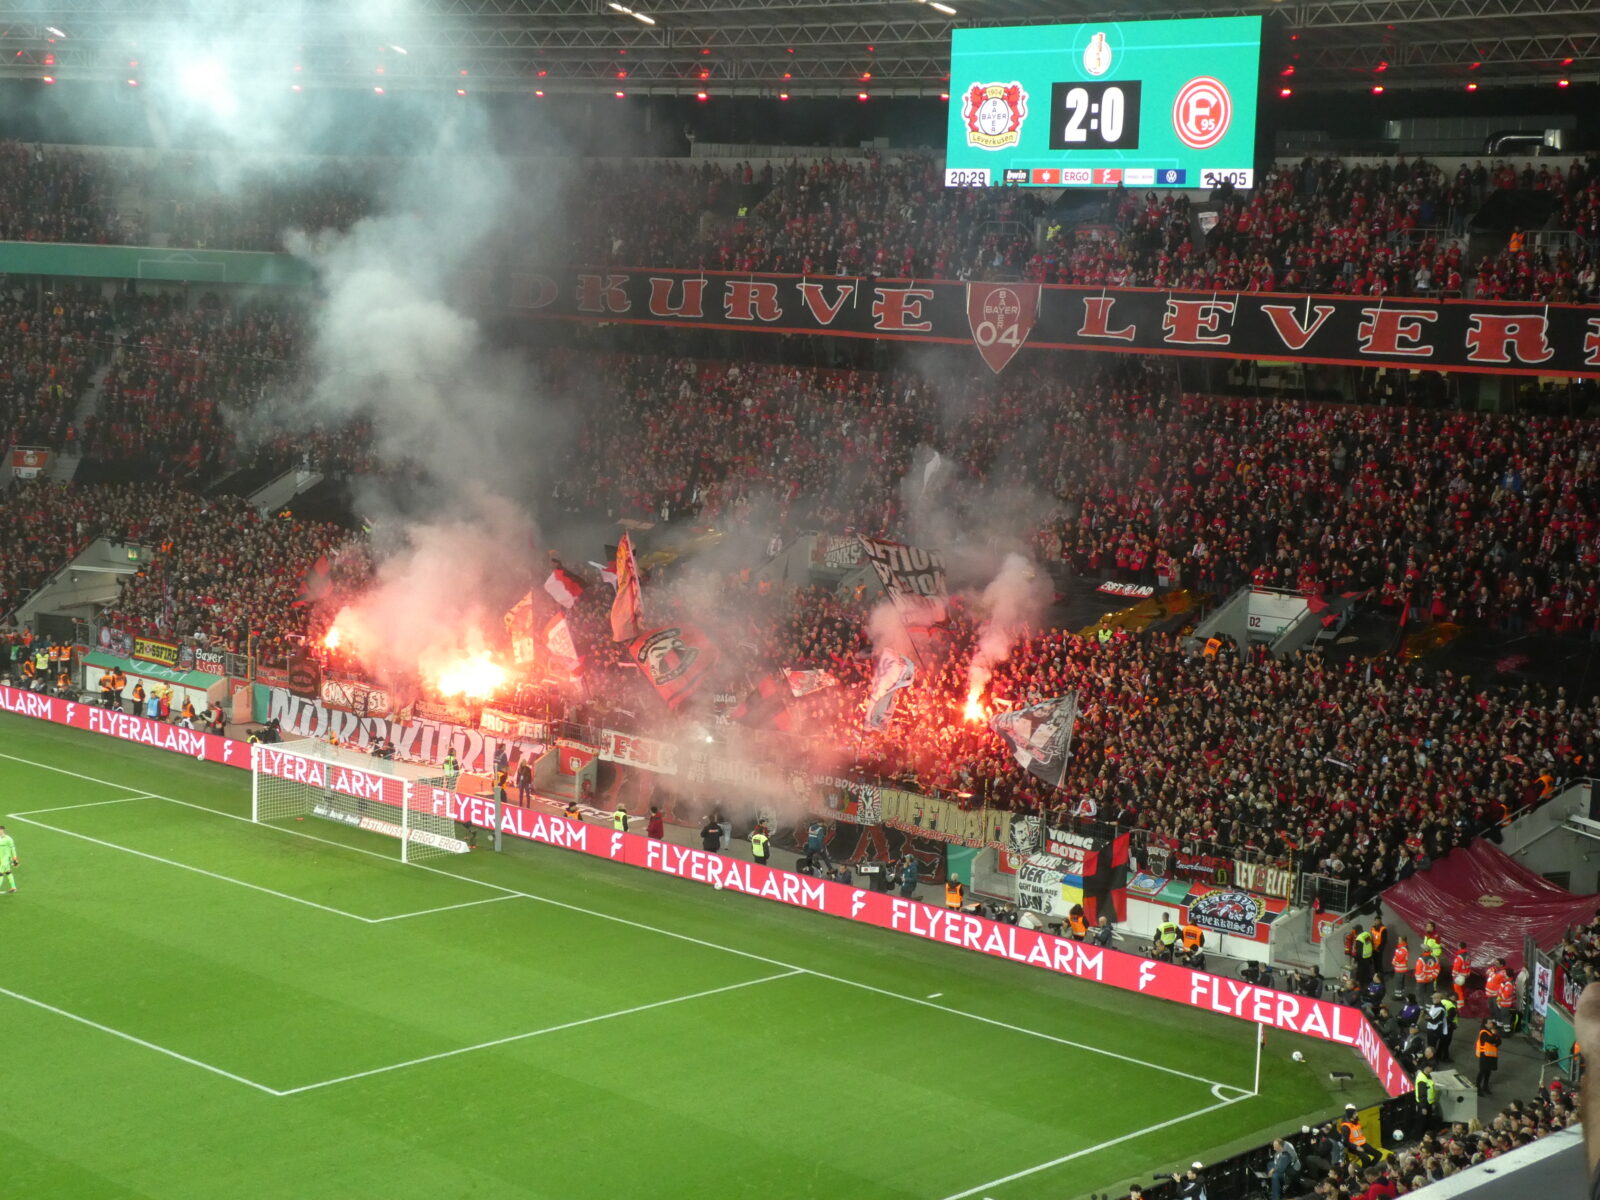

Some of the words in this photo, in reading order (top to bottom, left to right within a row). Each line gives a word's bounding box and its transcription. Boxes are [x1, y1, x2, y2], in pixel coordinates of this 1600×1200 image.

[1064, 87, 1124, 142] 2:0
[972, 134, 1014, 145] Leverkusen
[950, 171, 986, 185] 20:29
[1064, 171, 1090, 181] ERGO
[1204, 172, 1247, 186] 2105
[976, 320, 1021, 349] 04
[1249, 616, 1261, 628] D2
[195, 648, 224, 663] Bayer
[88, 708, 206, 756] FLYERALARM
[432, 789, 587, 851] FLYERALARM
[647, 840, 825, 911] FLYERALARM
[891, 899, 1103, 980] FLYERALARM
[412, 829, 436, 845] ERGO
[438, 837, 462, 851] ERGO
[1048, 828, 1094, 850] YOUNG
[1050, 842, 1085, 862] BOYS
[1019, 864, 1046, 884] DER
[1234, 861, 1257, 889] LEV
[1265, 869, 1297, 899] ELITE
